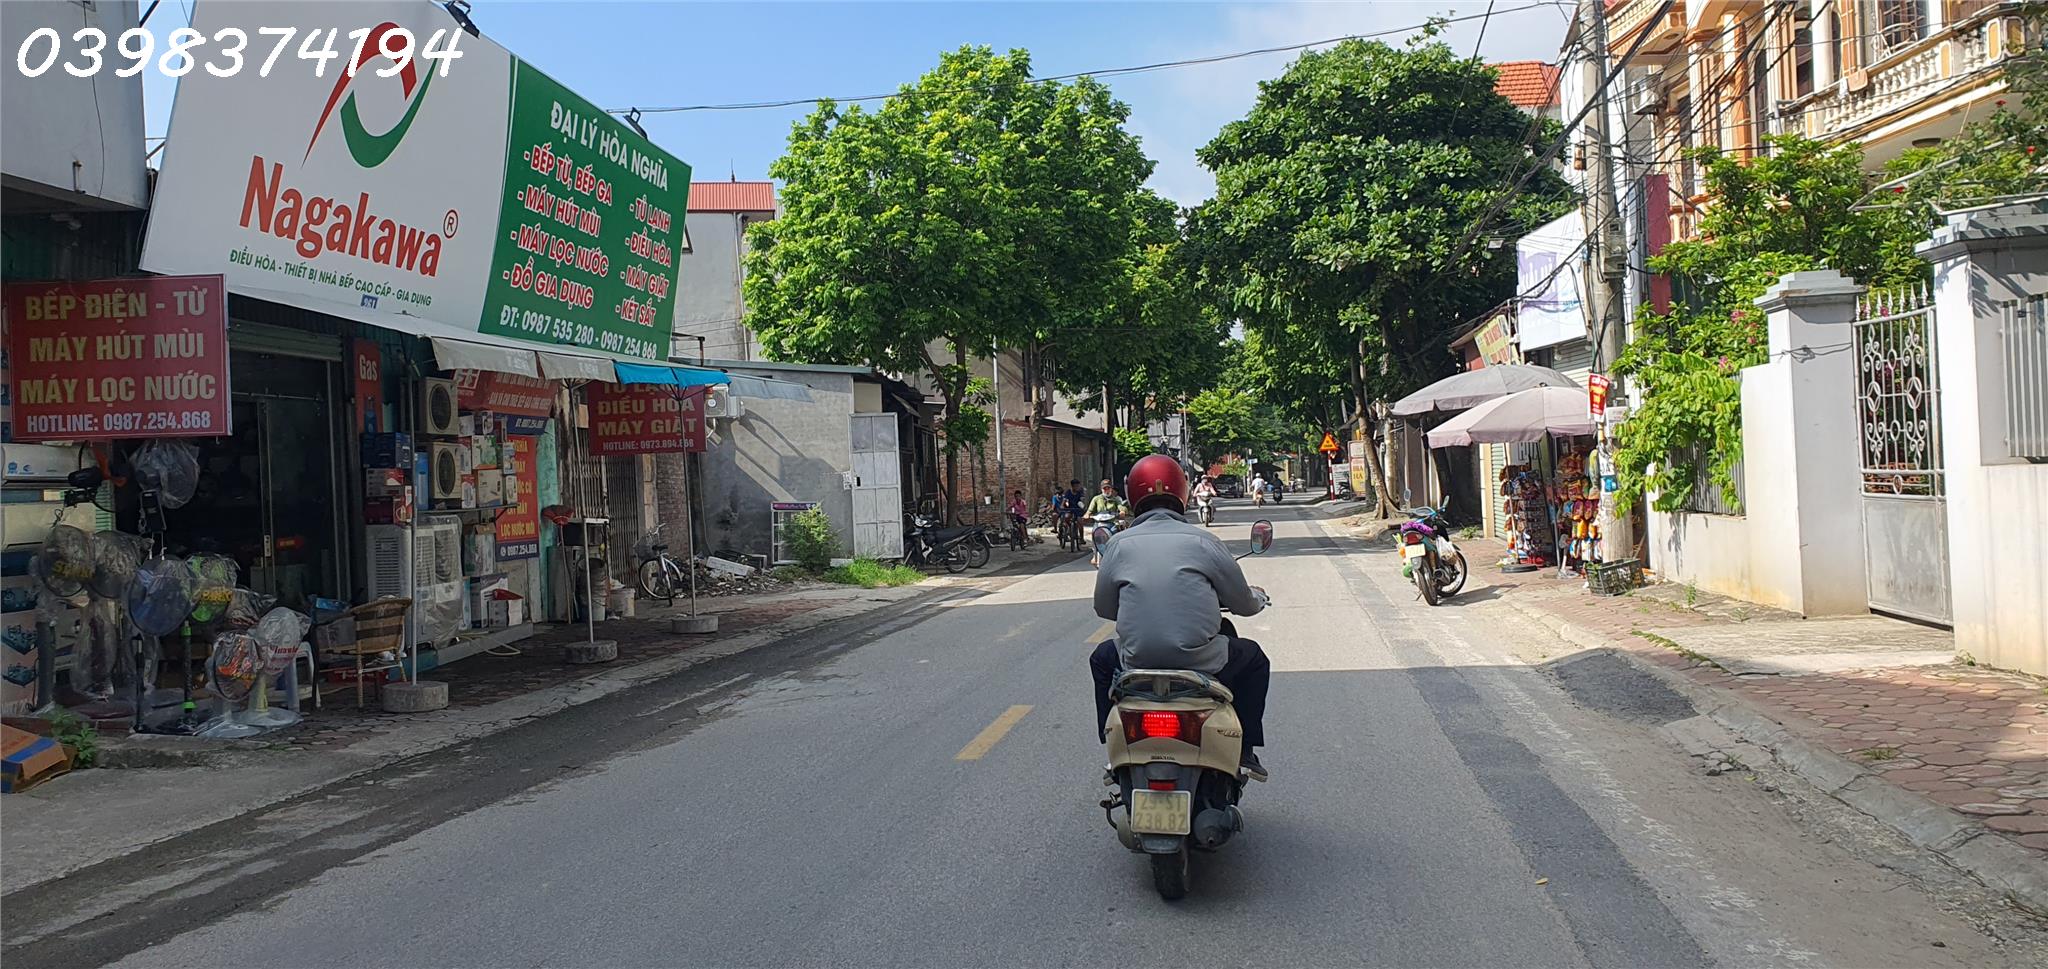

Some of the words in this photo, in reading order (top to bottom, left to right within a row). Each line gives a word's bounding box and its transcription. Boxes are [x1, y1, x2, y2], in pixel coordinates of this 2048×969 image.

[550, 100, 580, 143] ĐẠI
[580, 117, 599, 149] LÝ
[599, 128, 628, 169] HÒA
[631, 149, 668, 191] NGHĨA
[531, 142, 556, 177] BẾP
[574, 165, 595, 197] BẾP
[595, 183, 613, 206] GA
[239, 155, 443, 278] Nagakawa
[524, 183, 555, 219] MÁY
[555, 195, 579, 229] HÚT
[579, 206, 602, 238] MÙI
[634, 194, 648, 222] TỦ
[648, 204, 672, 234] LẠNH
[517, 222, 549, 258] MÁY
[548, 235, 576, 268] LỌC
[576, 246, 610, 278] NƯỚC
[630, 231, 652, 259] ĐIỀU
[652, 237, 673, 268] HÒA
[230, 246, 253, 266] ĐIỀU
[255, 254, 276, 273] HÒA
[284, 261, 307, 279] THIẾT
[307, 268, 318, 285] BỊ
[318, 270, 337, 286] NHÀ
[339, 272, 354, 289] BẾP
[355, 280, 373, 295] CAO
[374, 280, 391, 297] CẤP
[396, 289, 410, 302] GIA
[410, 292, 431, 306] DỤNG
[511, 255, 534, 292] ĐỒ
[534, 271, 558, 301] GIA
[560, 281, 595, 311] DỤNG
[626, 265, 648, 292] MÁY
[648, 272, 670, 302] GIẶT
[25, 286, 76, 320] BẾP
[84, 287, 147, 324] ĐIỆN
[173, 285, 208, 317] TỪ
[620, 298, 639, 323] KÉT
[29, 332, 88, 362] MÁY
[96, 330, 146, 361] HÚT
[154, 327, 205, 359] MÙI
[500, 304, 520, 328] ĐT:
[521, 310, 550, 336] 0987
[553, 317, 574, 340] 535
[575, 323, 594, 343] 280
[601, 330, 623, 353] 0987
[624, 337, 641, 358] 254
[641, 341, 658, 361] 868
[359, 353, 378, 382] Gas
[20, 373, 79, 404] MÁY
[86, 376, 136, 408] LỌC
[144, 369, 217, 401] NƯỚC
[598, 395, 646, 416] ĐIỀU
[27, 412, 99, 434] HOTLINE:
[103, 410, 211, 432] 0987.254.868
[598, 418, 643, 437] MÁY
[651, 415, 697, 436] GIẶT
[603, 440, 639, 451] HOTLINE:
